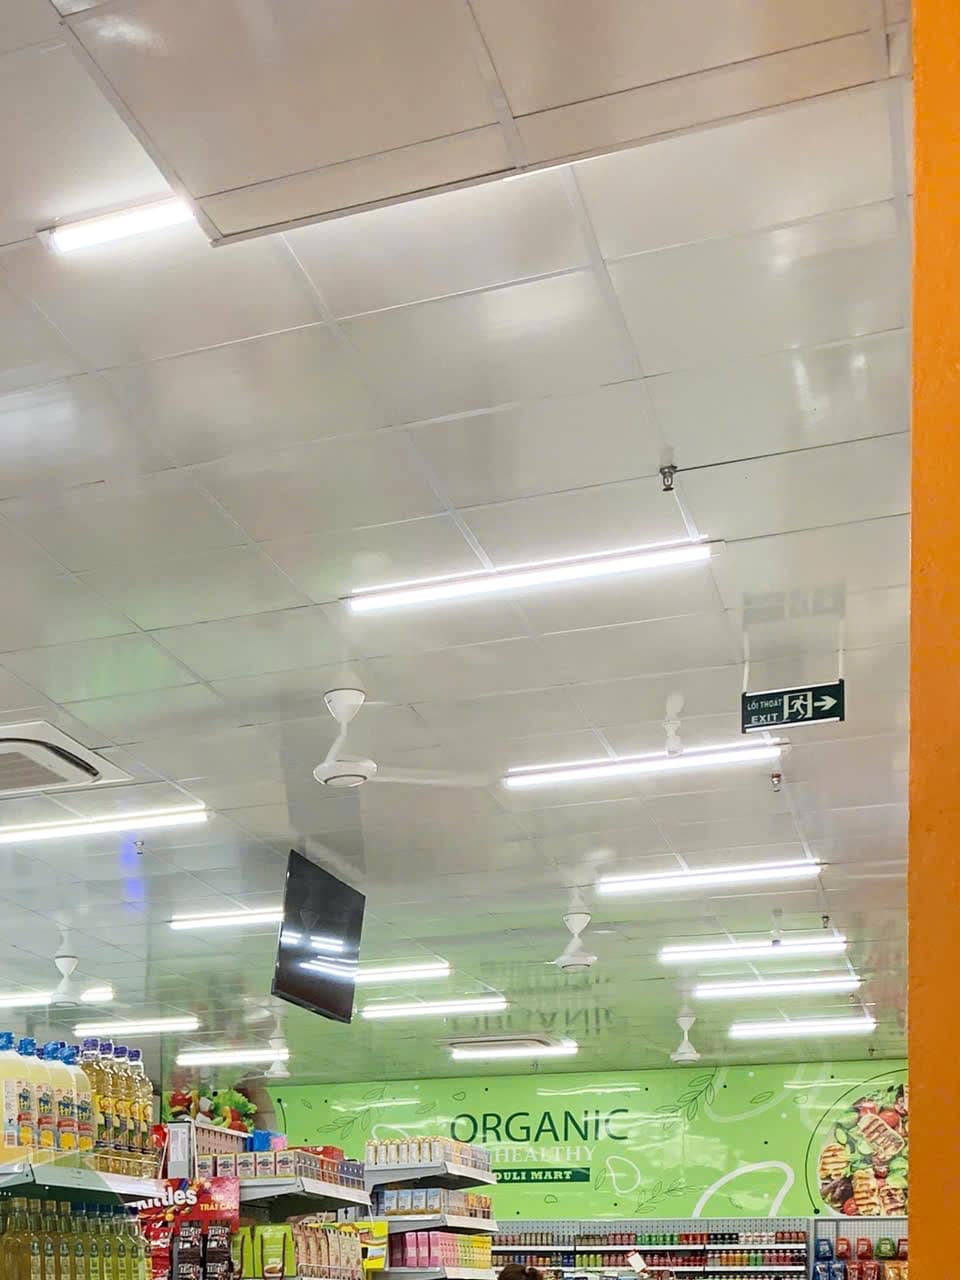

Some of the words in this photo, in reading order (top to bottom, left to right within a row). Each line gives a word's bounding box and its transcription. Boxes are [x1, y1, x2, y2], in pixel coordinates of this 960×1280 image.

[747, 698, 759, 711] LỐI
[760, 697, 782, 708] THOÁT
[751, 713, 779, 724] EXIT
[495, 1146, 597, 1162] HEALTHY
[530, 1170, 573, 1181] MART
